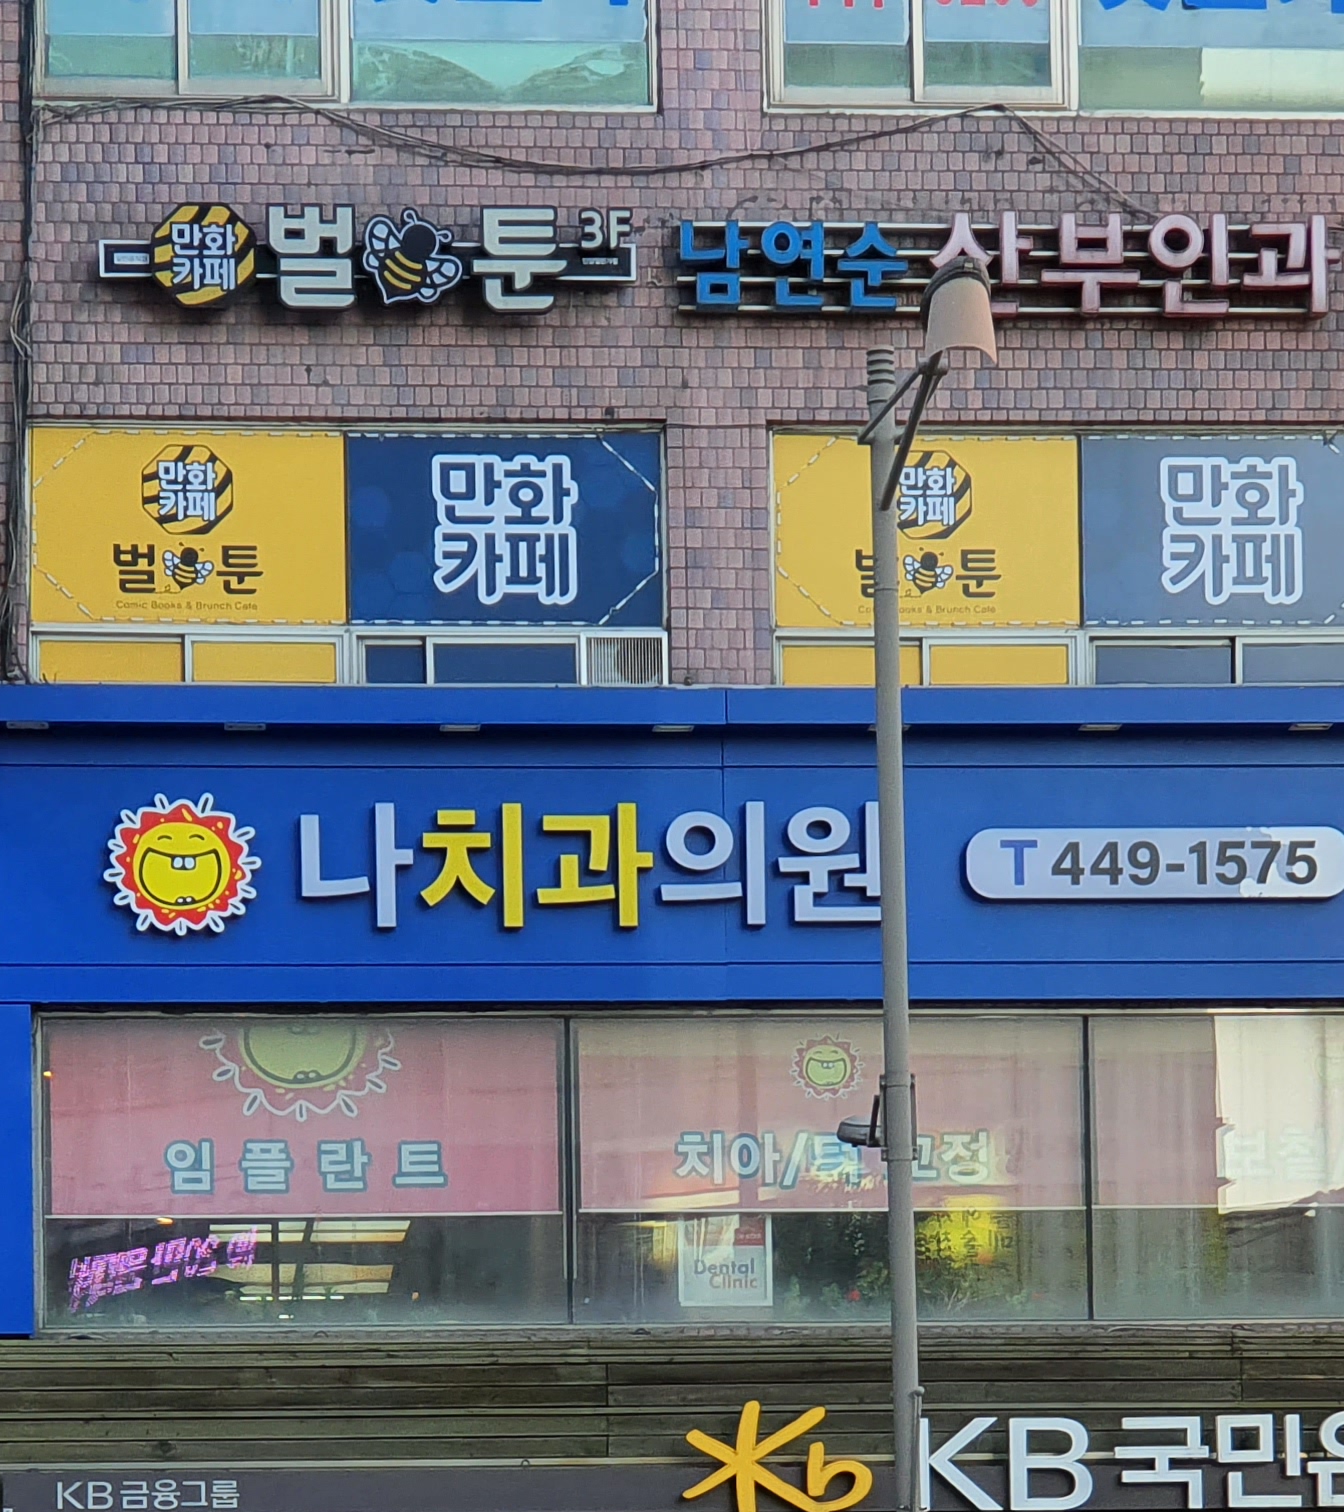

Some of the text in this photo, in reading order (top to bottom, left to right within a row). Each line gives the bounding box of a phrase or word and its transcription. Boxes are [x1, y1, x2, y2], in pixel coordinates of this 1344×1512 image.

[170, 222, 236, 256] 만화
[580, 209, 631, 249] 3F
[170, 255, 238, 292] 카페
[679, 220, 909, 310] 남연순
[157, 460, 216, 490] 만화
[435, 456, 576, 524] 만화
[898, 468, 955, 496] 만화
[1161, 456, 1304, 526] 만화
[158, 490, 216, 521] 카페
[896, 495, 955, 526] 카페
[435, 529, 577, 605] 카페
[1162, 531, 1302, 605] 카페
[300, 801, 882, 928] 나치과의원
[1000, 838, 1318, 888] T 449-1575
[163, 1138, 449, 1195] 임플란트
[693, 1257, 756, 1276] Dental
[709, 1273, 758, 1290] Clinic
